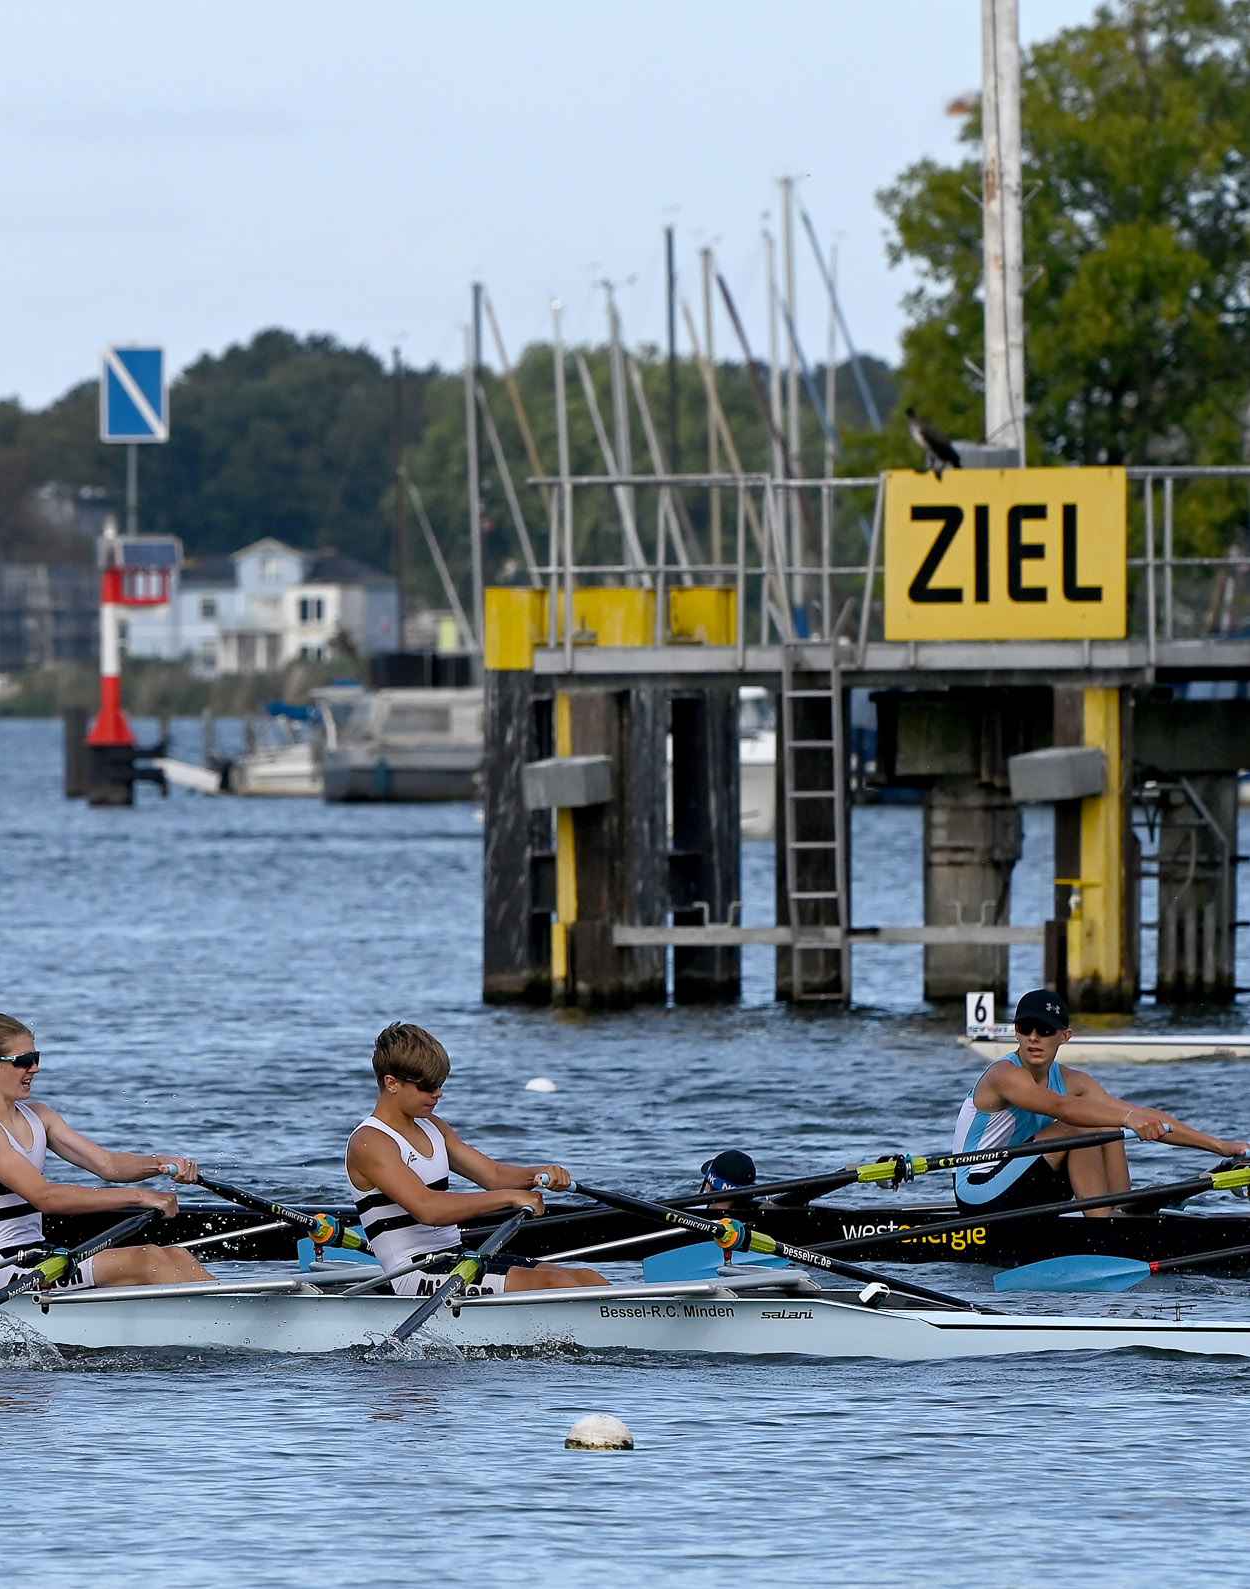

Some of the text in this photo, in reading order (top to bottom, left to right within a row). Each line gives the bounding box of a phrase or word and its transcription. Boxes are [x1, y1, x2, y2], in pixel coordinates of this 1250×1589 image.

[908, 504, 1103, 603] ZIEL
[974, 995, 987, 1023] 6
[955, 1150, 1009, 1165] concept 2
[308, 1218, 314, 1226] 2
[677, 1216, 718, 1234] concept 2
[782, 1244, 832, 1269] besselrc.de
[599, 1304, 735, 1319] Bessel-R.C. Minden
